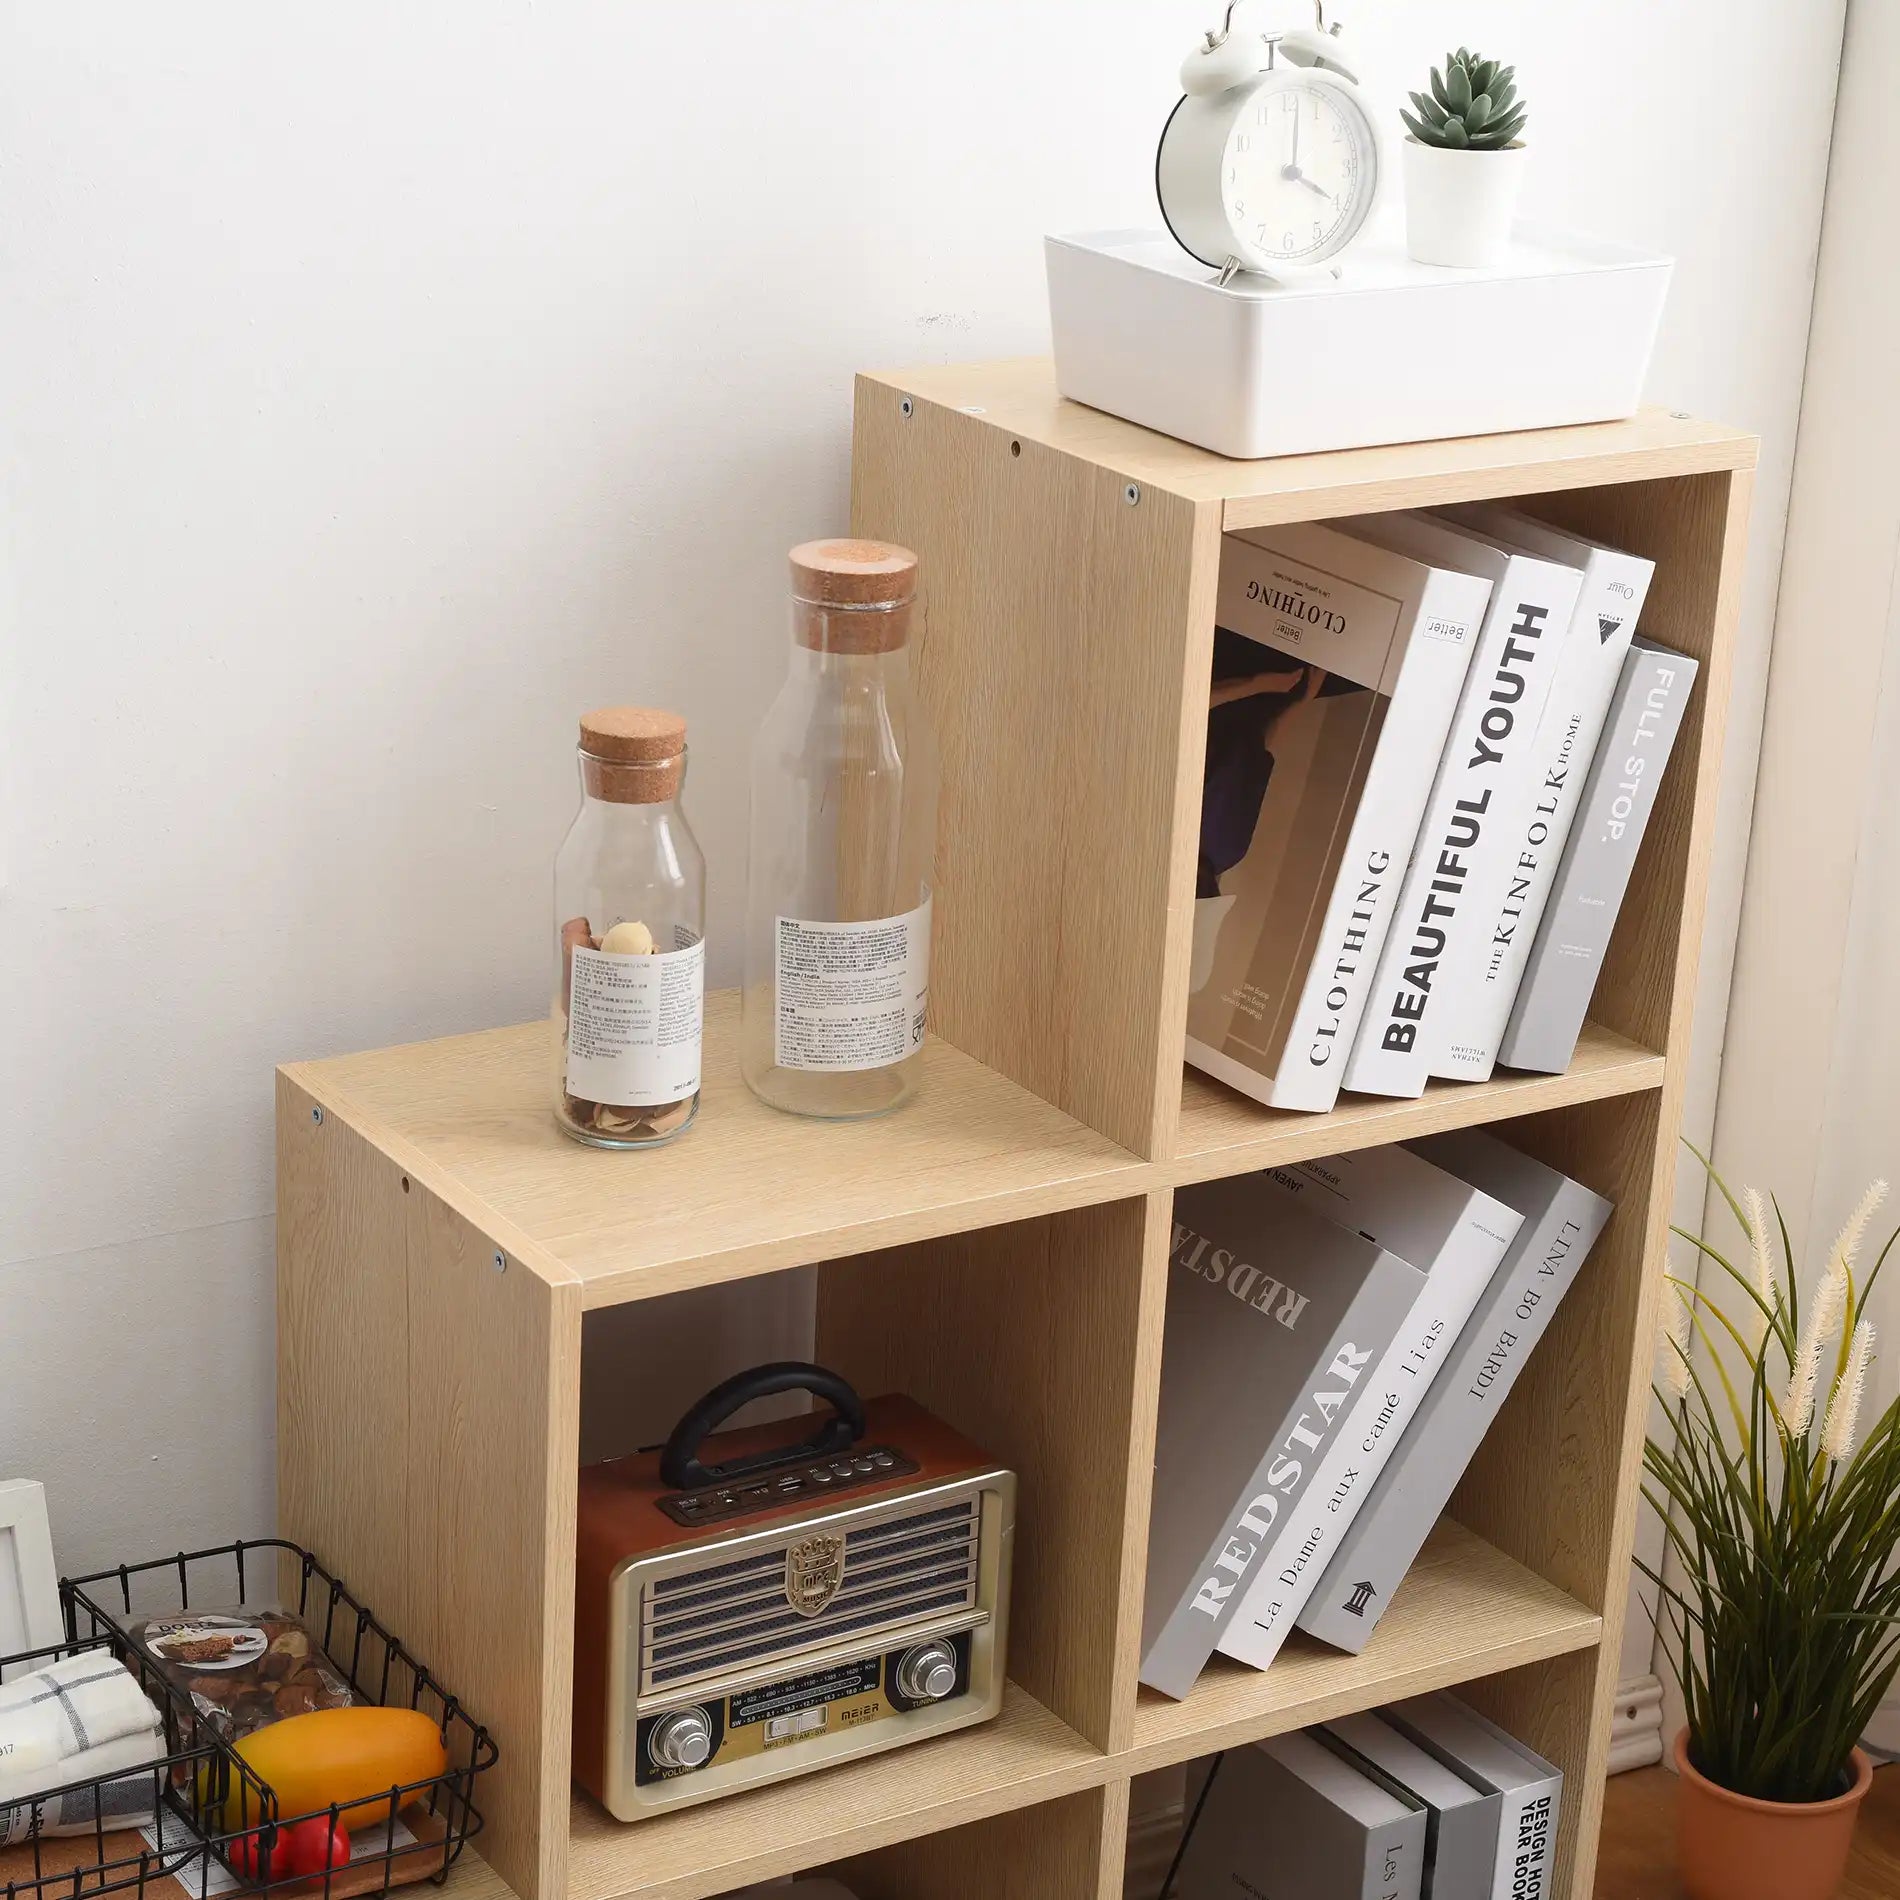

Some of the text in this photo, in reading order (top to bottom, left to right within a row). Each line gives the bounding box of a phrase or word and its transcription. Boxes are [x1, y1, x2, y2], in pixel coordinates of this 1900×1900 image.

[1282, 94, 1297, 112] 12
[1313, 101, 1321, 120] 1
[1256, 107, 1268, 125] 11
[1236, 134, 1250, 152] 10
[1332, 124, 1343, 143] 2
[1342, 159, 1351, 178] 3
[1234, 200, 1245, 219] 8
[1330, 193, 1341, 211] 4
[1257, 224, 1266, 243] 7
[1282, 231, 1293, 251] 6
[1312, 221, 1322, 240] 5
[1246, 581, 1346, 634] CLOTHING
[1277, 623, 1301, 641] Better
[1428, 620, 1465, 640] Better
[1601, 667, 1675, 841] FULL STOP.
[1381, 603, 1549, 1053] BEAUTIFUL YOUTH
[1485, 712, 1582, 982] THE KINFOLK HOME
[1309, 850, 1390, 1066] CLOTHING
[1271, 1170, 1304, 1192] JAVEN
[1168, 1222, 1311, 1330] REDSTA
[1515, 1290, 1542, 1320] BO
[1467, 1328, 1518, 1402] BARDI
[1189, 1340, 1375, 1622] REDSTAR
[1254, 1318, 1445, 1633] La Dame aux camé lias
[732, 1699, 742, 1707] AM
[763, 1727, 827, 1750] MP3 FM AM SW
[662, 1766, 696, 1779] VOLUME
[1530, 1796, 1551, 1862] DESIGN
[1511, 1800, 1536, 1900] YEAR BOOK
[1383, 1844, 1403, 1882] Les
